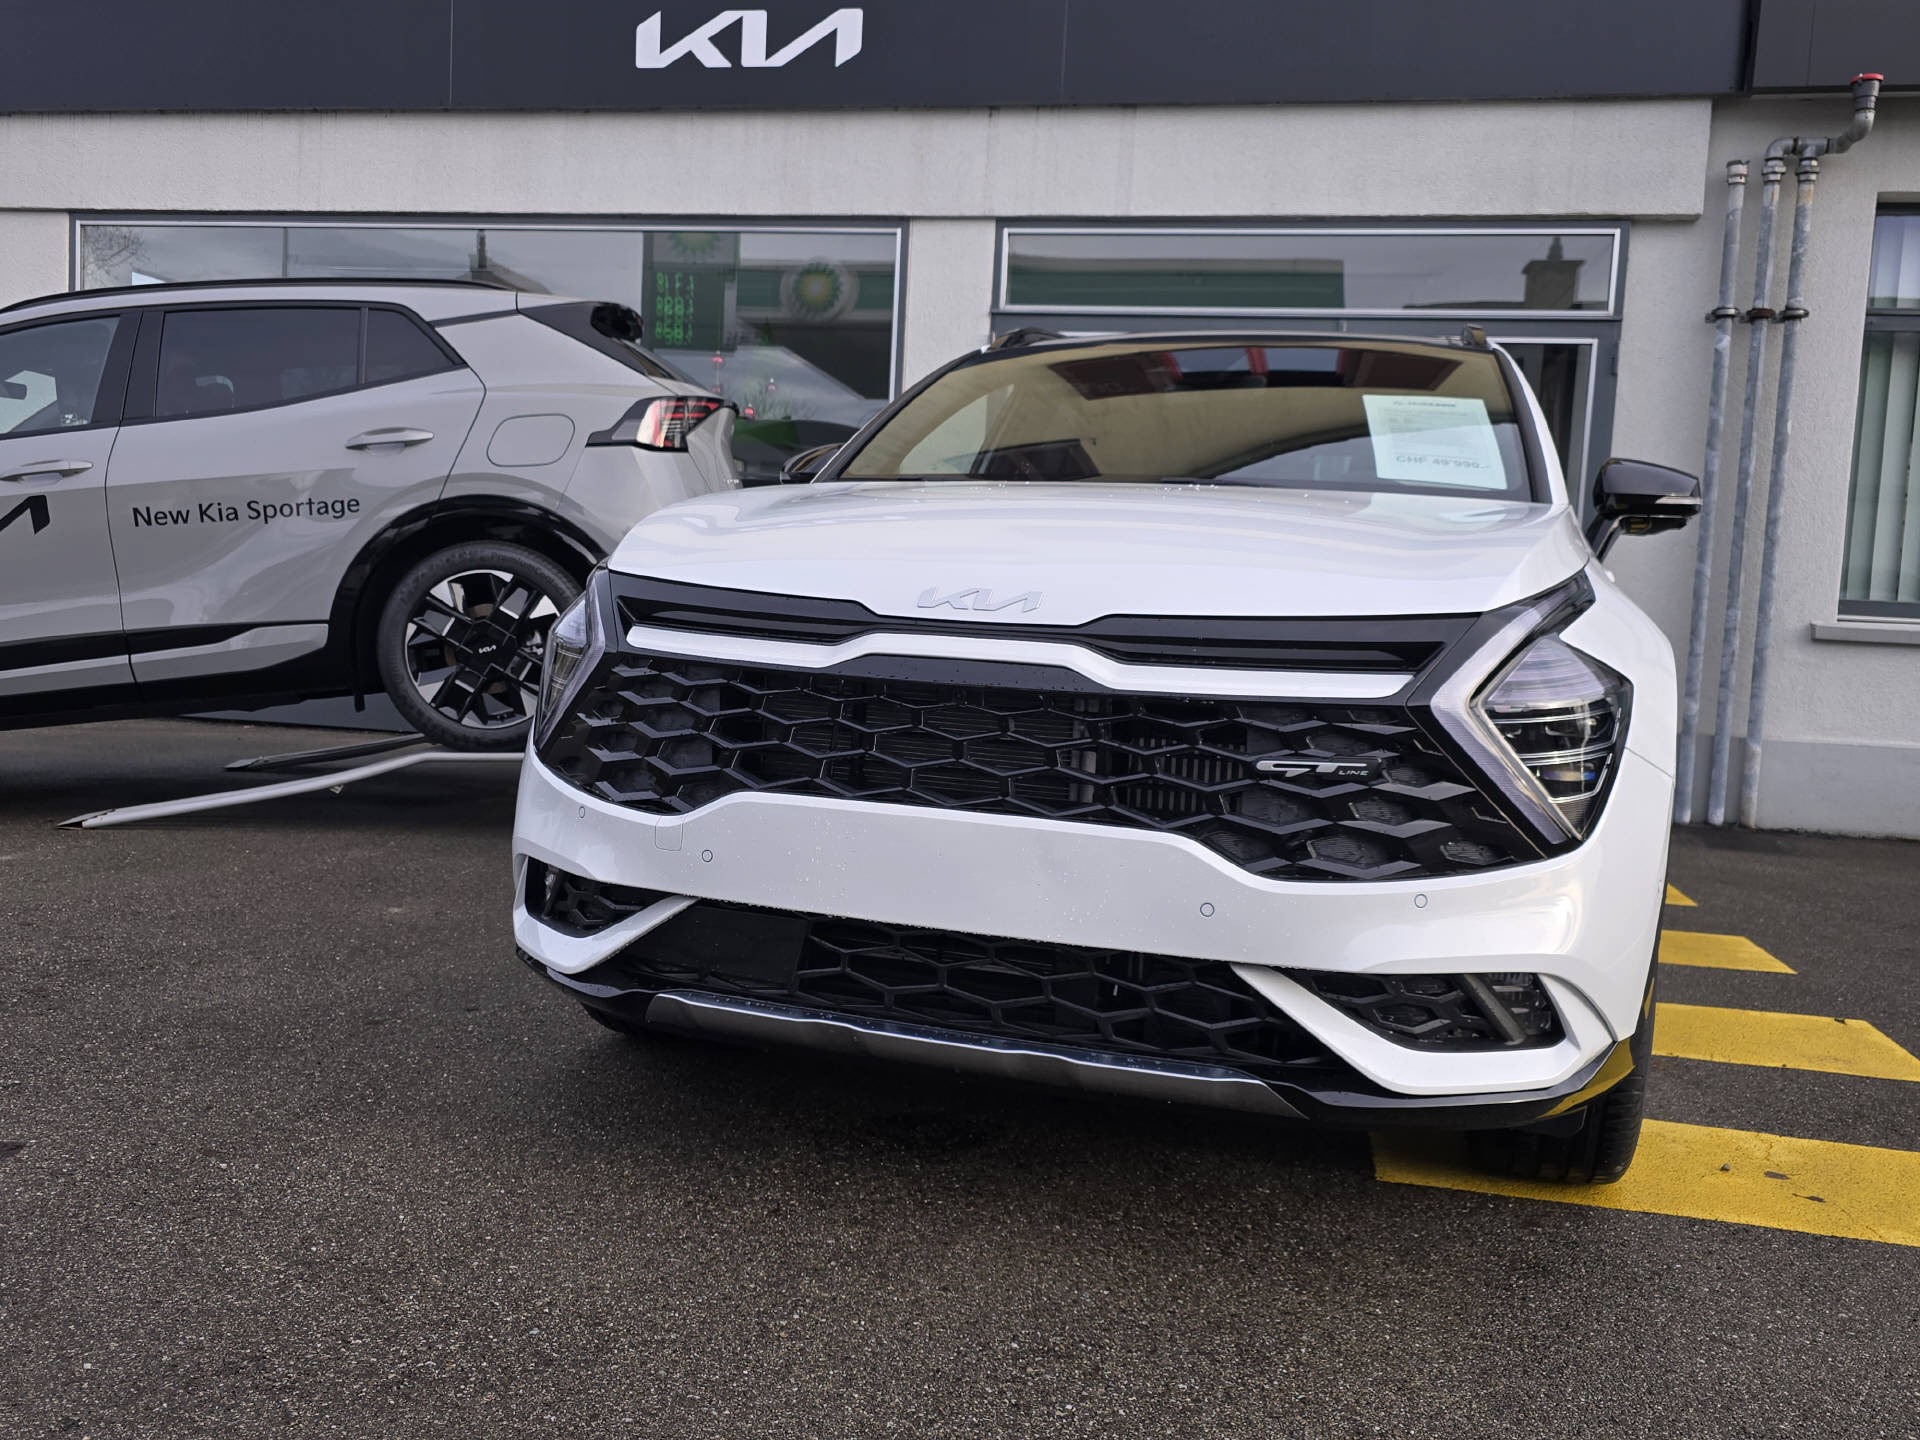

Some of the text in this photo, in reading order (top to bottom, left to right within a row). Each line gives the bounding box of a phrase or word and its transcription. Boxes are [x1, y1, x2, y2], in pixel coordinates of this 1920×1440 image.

[635, 8, 864, 69] KIA
[1395, 455, 1427, 465] CHF
[132, 497, 360, 528] New Kia Sportage
[917, 587, 1043, 613] KIA
